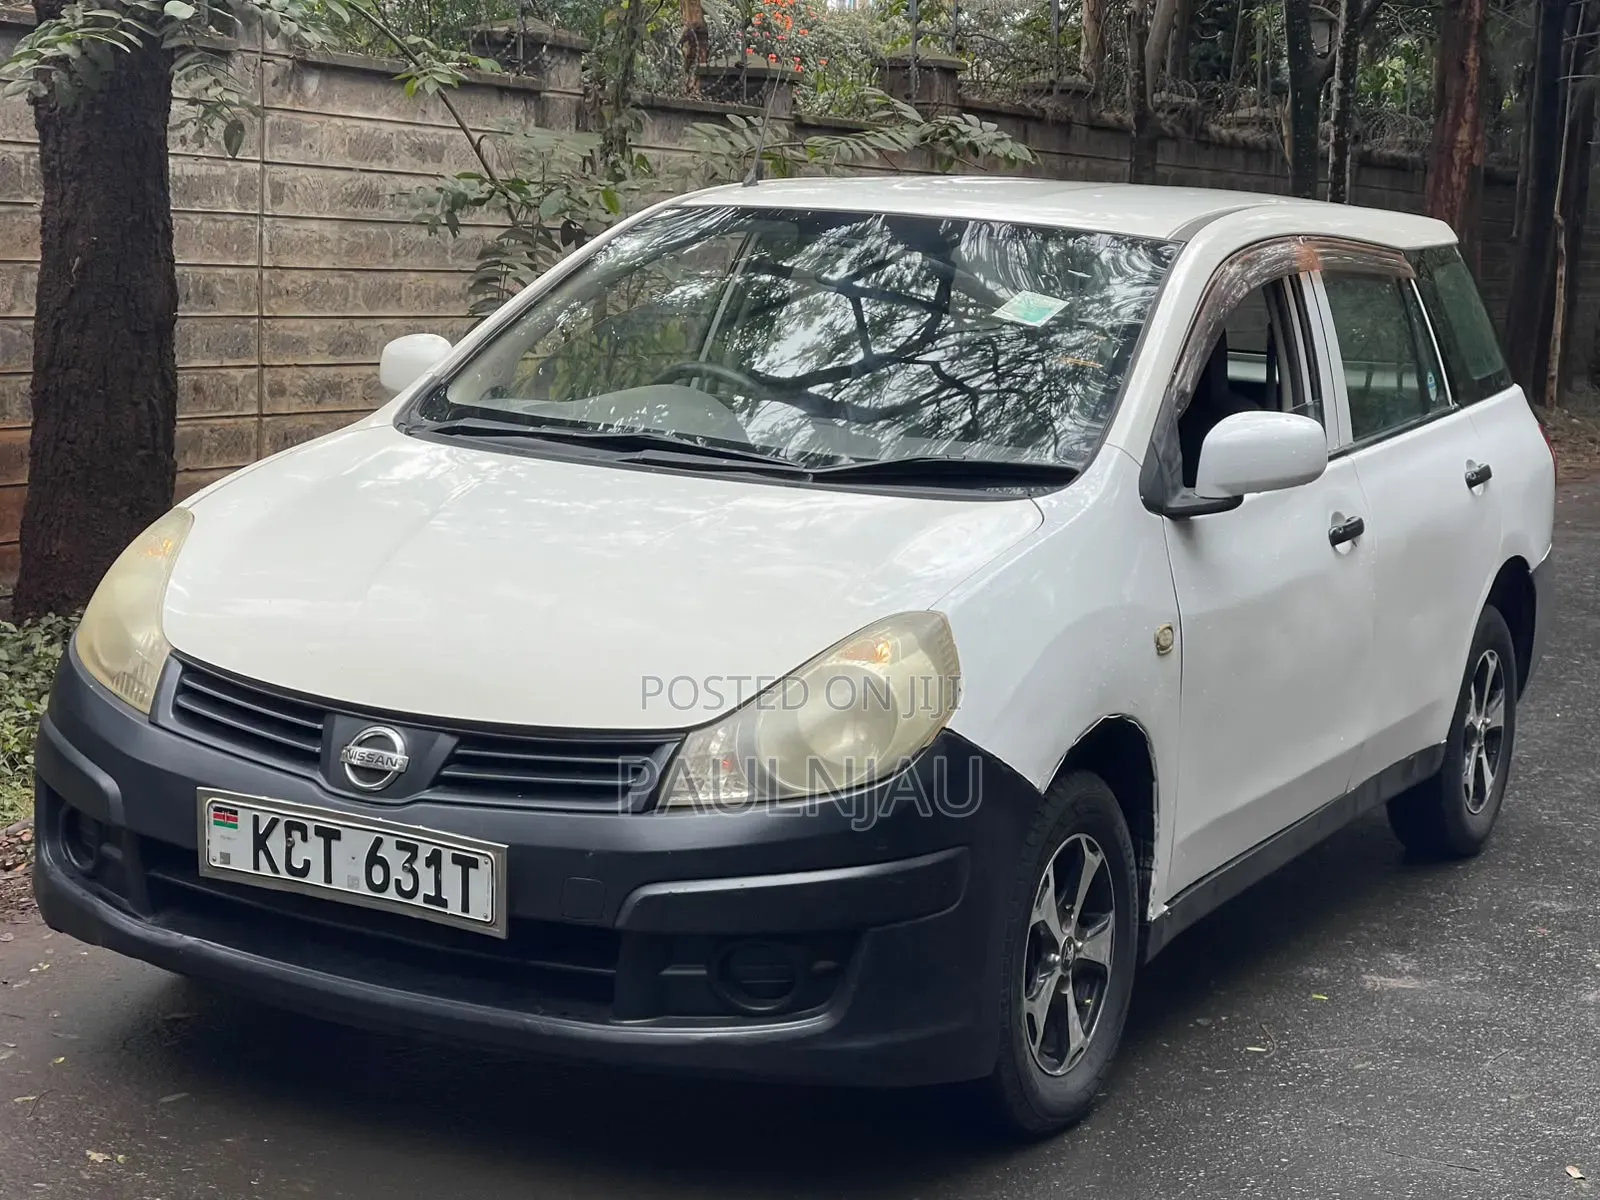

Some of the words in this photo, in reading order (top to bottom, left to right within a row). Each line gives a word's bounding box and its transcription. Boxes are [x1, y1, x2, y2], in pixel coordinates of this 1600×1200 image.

[345, 749, 399, 768] NISSAN
[252, 813, 341, 884] KCT
[364, 835, 479, 913] 631T
